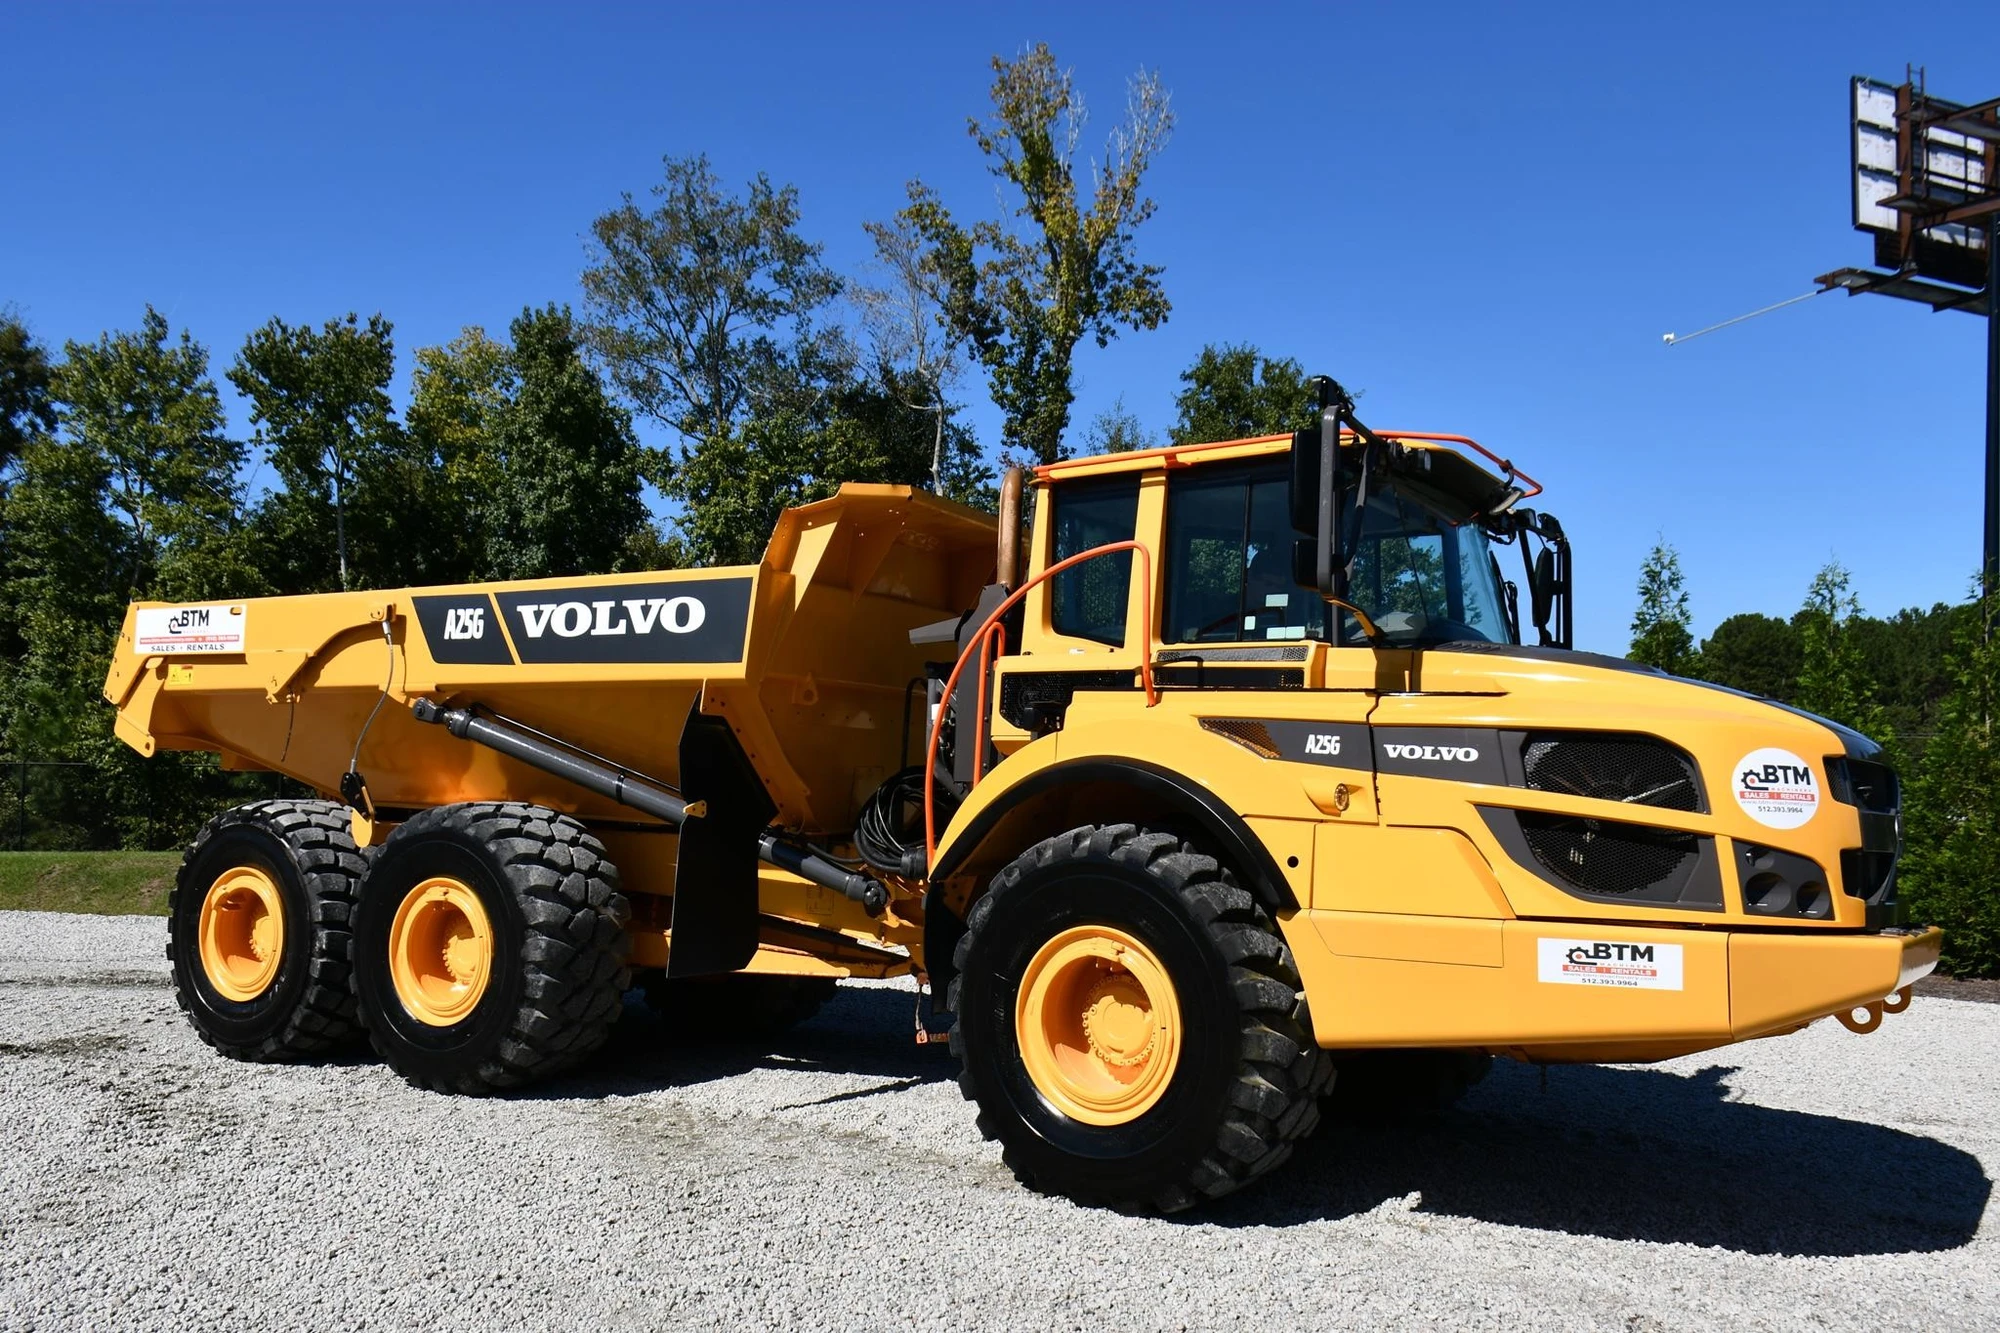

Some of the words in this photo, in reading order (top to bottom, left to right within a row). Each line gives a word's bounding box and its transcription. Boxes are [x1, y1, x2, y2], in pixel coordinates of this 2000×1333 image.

[181, 609, 209, 627] BTM
[443, 607, 484, 640] A25G
[516, 596, 706, 638] VOLVO
[151, 644, 176, 652] SALES
[187, 643, 225, 651] RENTALS
[1305, 734, 1341, 755] A25G
[1383, 744, 1479, 762] VOLVO
[1763, 764, 1811, 785] BTM
[1780, 793, 1812, 801] RENTALS
[1593, 942, 1654, 962] BTM
[1567, 965, 1597, 973] SALES
[1610, 967, 1652, 976] RENTALS
[1581, 978, 1638, 986] 512.393.9964
